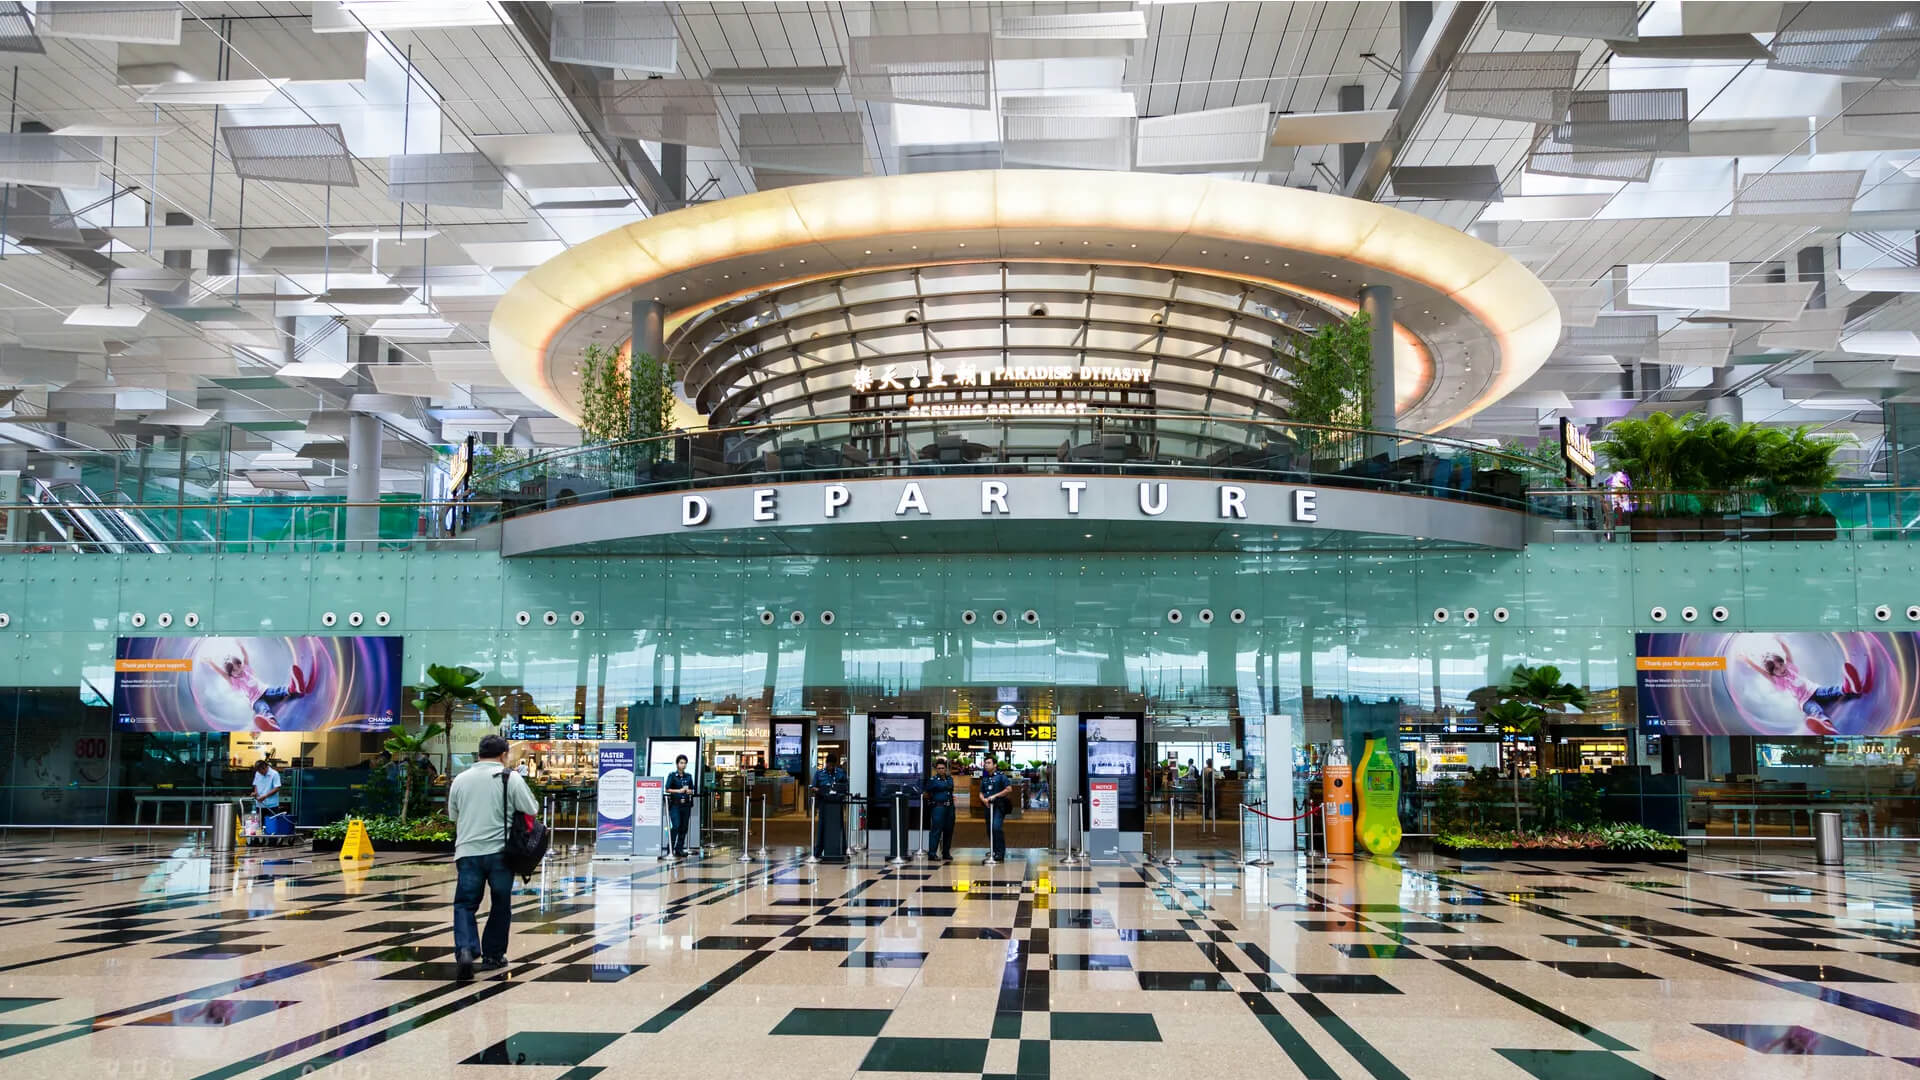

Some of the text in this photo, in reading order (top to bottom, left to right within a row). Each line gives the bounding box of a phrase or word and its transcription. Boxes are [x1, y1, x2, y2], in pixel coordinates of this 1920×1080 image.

[994, 366, 1152, 383] PARADISE DYNASTY
[681, 478, 1319, 527] DEPARTURE
[970, 728, 982, 737] A1
[989, 728, 1005, 737] A21
[942, 742, 961, 751] PAUL
[992, 742, 1014, 751] PAUL
[600, 751, 625, 759] FASTER
